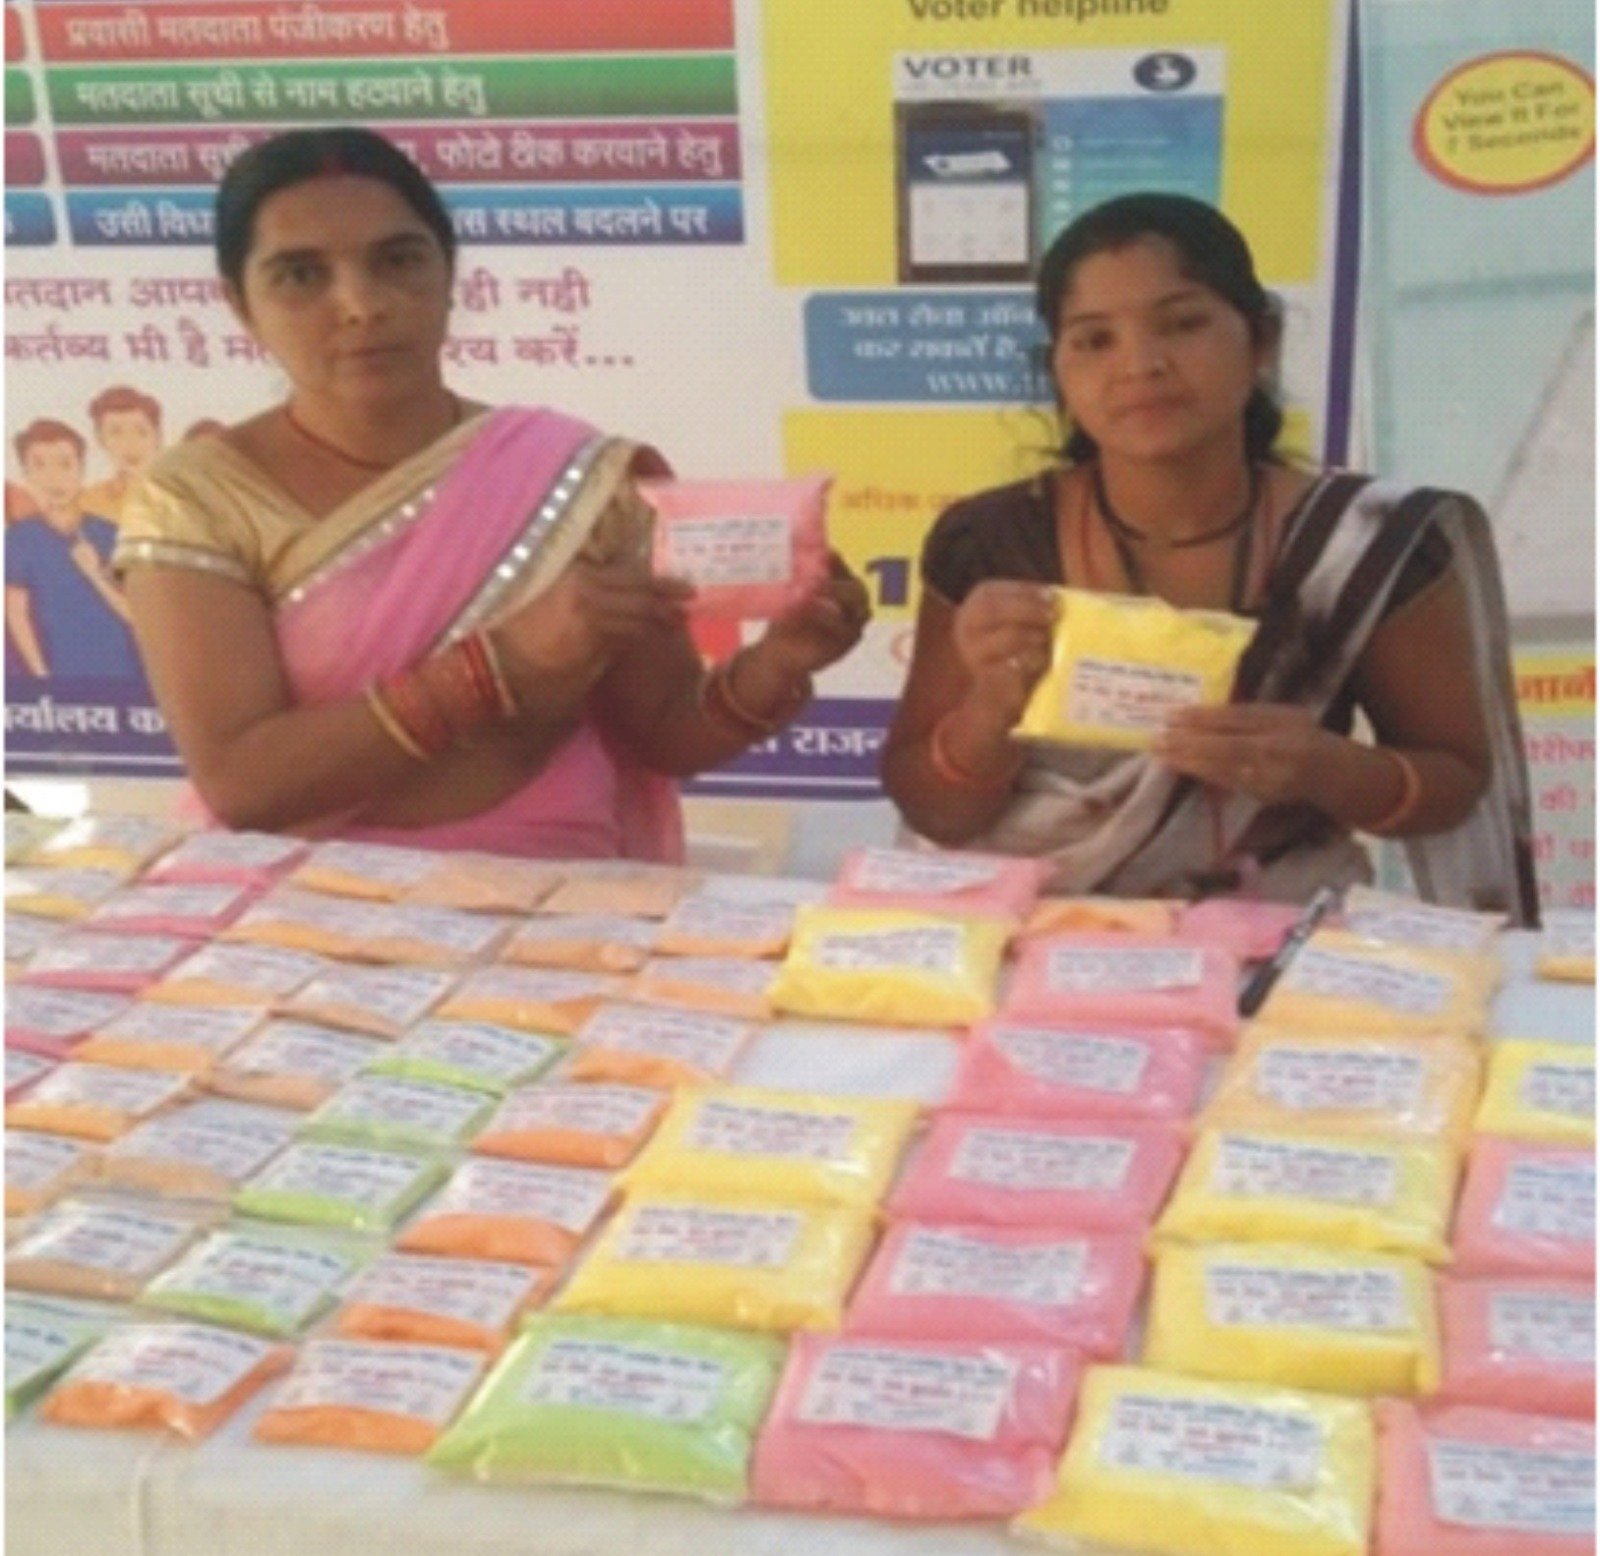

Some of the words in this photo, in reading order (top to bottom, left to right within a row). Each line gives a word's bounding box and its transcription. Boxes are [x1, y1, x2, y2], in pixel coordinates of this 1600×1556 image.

[157, 16, 262, 44] मतदाता
[404, 5, 449, 49] हेतु
[909, 0, 998, 19] Voter
[1017, 0, 1169, 23] helpline
[904, 57, 1032, 79] VOTER
[76, 82, 180, 110] मतदाता
[251, 70, 279, 108] से
[285, 78, 337, 107] नाम
[443, 67, 486, 115] हेतु
[88, 144, 189, 174] मतदाता
[571, 128, 670, 169] करवाने
[677, 128, 724, 177] हेतु
[95, 199, 150, 236] उसी
[494, 206, 567, 236] स्थल
[574, 196, 662, 236] बदलने
[669, 206, 709, 236] पर
[459, 267, 499, 312] ही
[124, 323, 169, 361] भी
[177, 315, 209, 368] है
